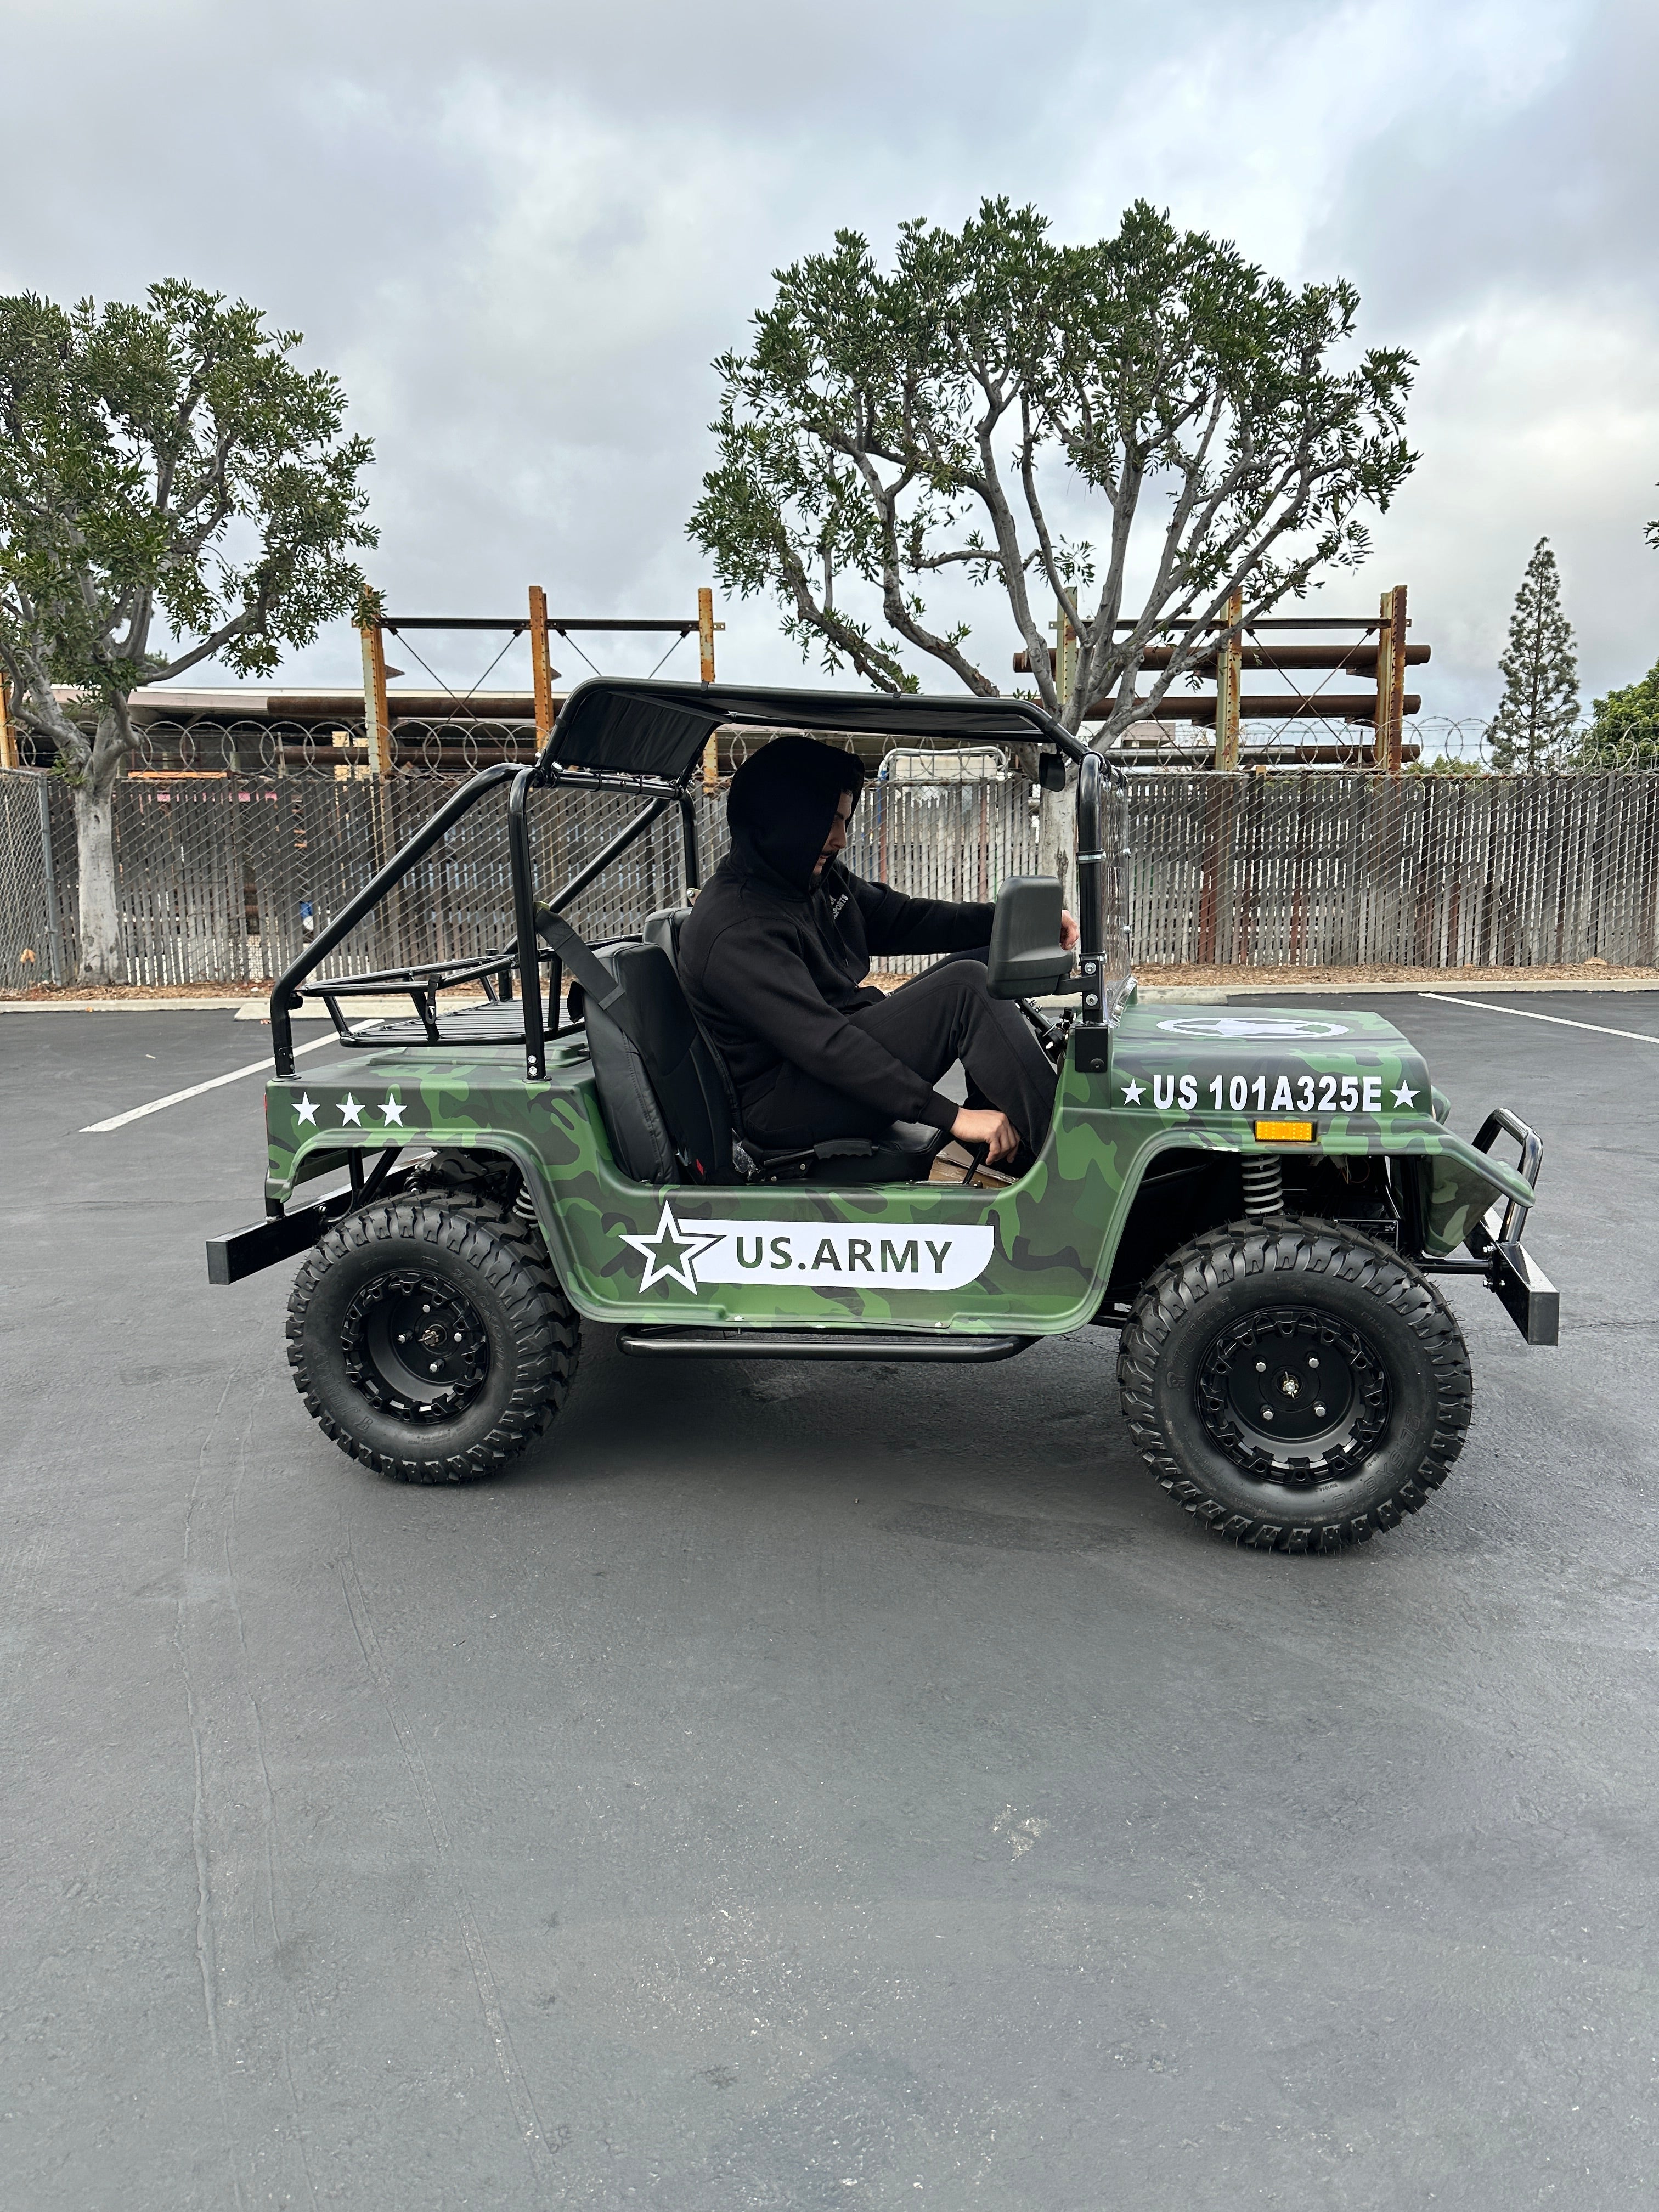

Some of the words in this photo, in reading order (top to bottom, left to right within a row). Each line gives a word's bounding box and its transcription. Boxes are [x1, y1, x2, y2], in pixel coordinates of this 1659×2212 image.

[833, 894, 849, 919] SPORTS
[1153, 1075, 1198, 1110] US
[1209, 1075, 1383, 1111] 101A325E
[737, 1236, 953, 1274] US.ARMY
